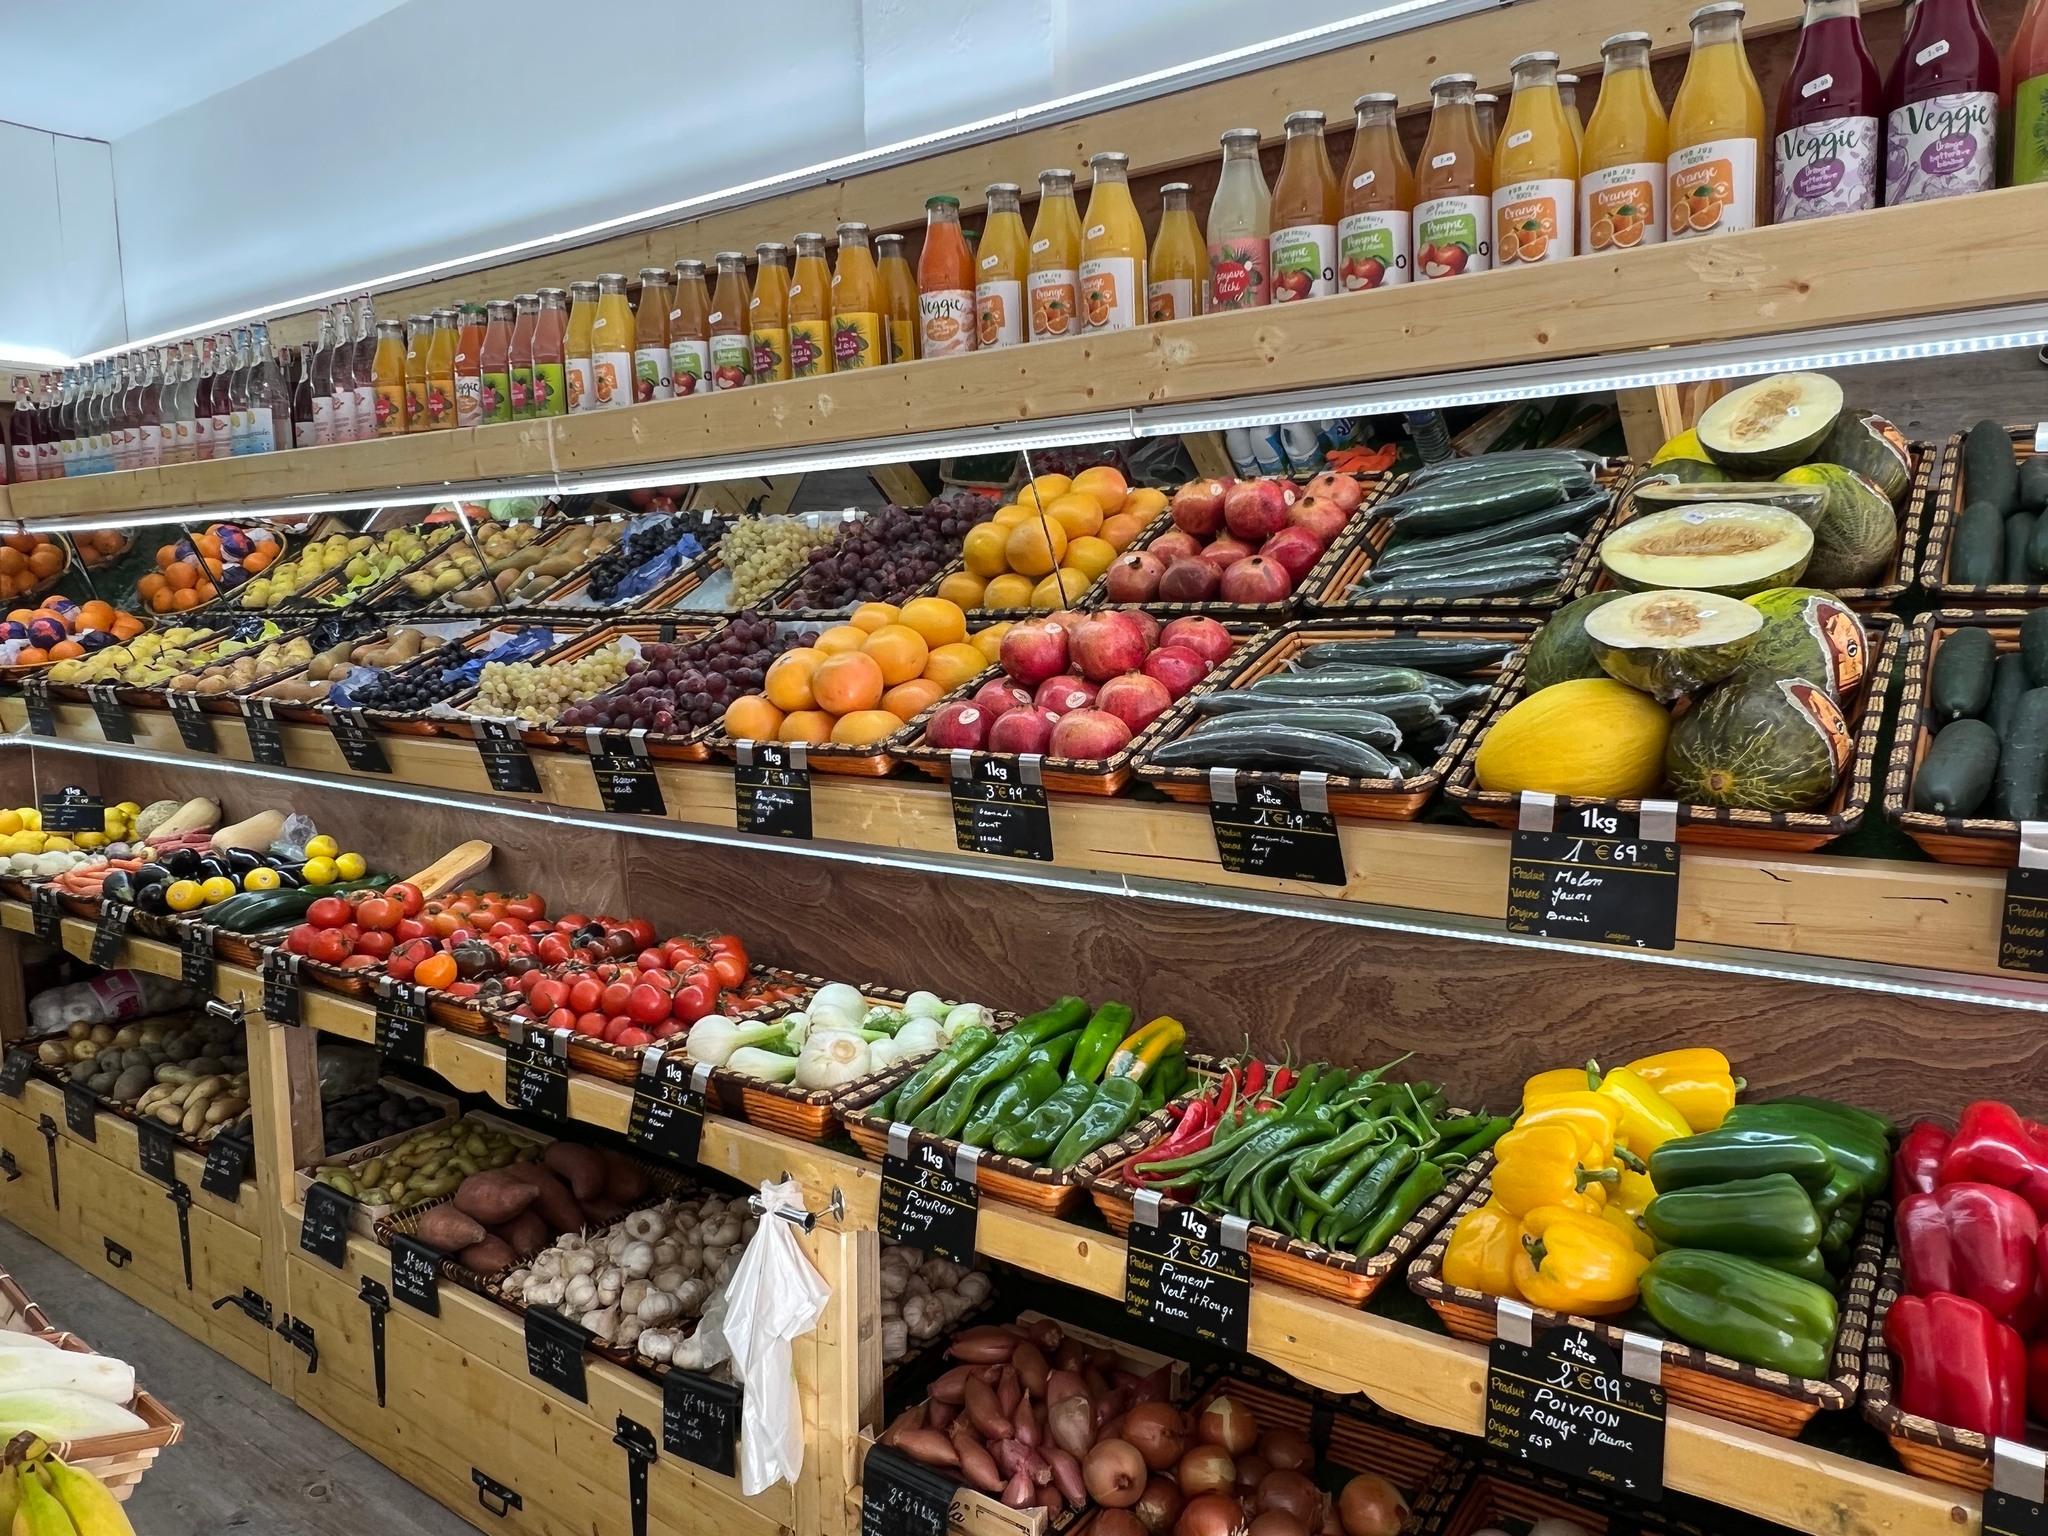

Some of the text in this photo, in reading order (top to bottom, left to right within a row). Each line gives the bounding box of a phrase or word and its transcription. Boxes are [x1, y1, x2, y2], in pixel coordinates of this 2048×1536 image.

[1905, 104, 1991, 140] Veggie
[1783, 128, 1861, 166] Veggie
[1676, 166, 1718, 187] Orange
[1598, 187, 1641, 205] Orange
[1504, 202, 1545, 219] Orange
[1427, 219, 1464, 235] Pomme
[1347, 233, 1381, 249] Pomme
[1036, 287, 1065, 301] Orange
[920, 297, 964, 319] Veggie
[763, 748, 781, 765] 1kg
[984, 761, 1007, 780] 1kg
[65, 787, 80, 795] 1kg
[986, 785, 1023, 800] 3 € 99
[1256, 793, 1281, 805] Pièce
[1262, 785, 1272, 796] la
[1254, 810, 1269, 826] 1
[1287, 814, 1303, 831] 49
[1580, 808, 1618, 834] 1kg
[1562, 839, 1637, 862] 1 € 69
[1555, 871, 1603, 886] Melon
[531, 1031, 545, 1048] 1kg
[666, 1064, 682, 1082] 1kg
[662, 1086, 669, 1099] 3
[921, 1146, 943, 1169] 1kg
[930, 1176, 940, 1189] €
[940, 1181, 953, 1192] 50
[1181, 1211, 1208, 1240] 1kg
[1189, 1245, 1201, 1261] €
[1200, 1249, 1219, 1268] 50
[1159, 1262, 1215, 1290] Piment
[1160, 1281, 1188, 1300] Vert
[1199, 1295, 1234, 1323] Rouge
[1576, 1331, 1588, 1348] la
[1563, 1338, 1597, 1364] Pièce
[1491, 1376, 1526, 1399] Produit
[1577, 1372, 1593, 1390] €
[1593, 1375, 1621, 1401] 99
[1488, 1418, 1520, 1438] Origine
[1588, 1427, 1634, 1452] Jaune
